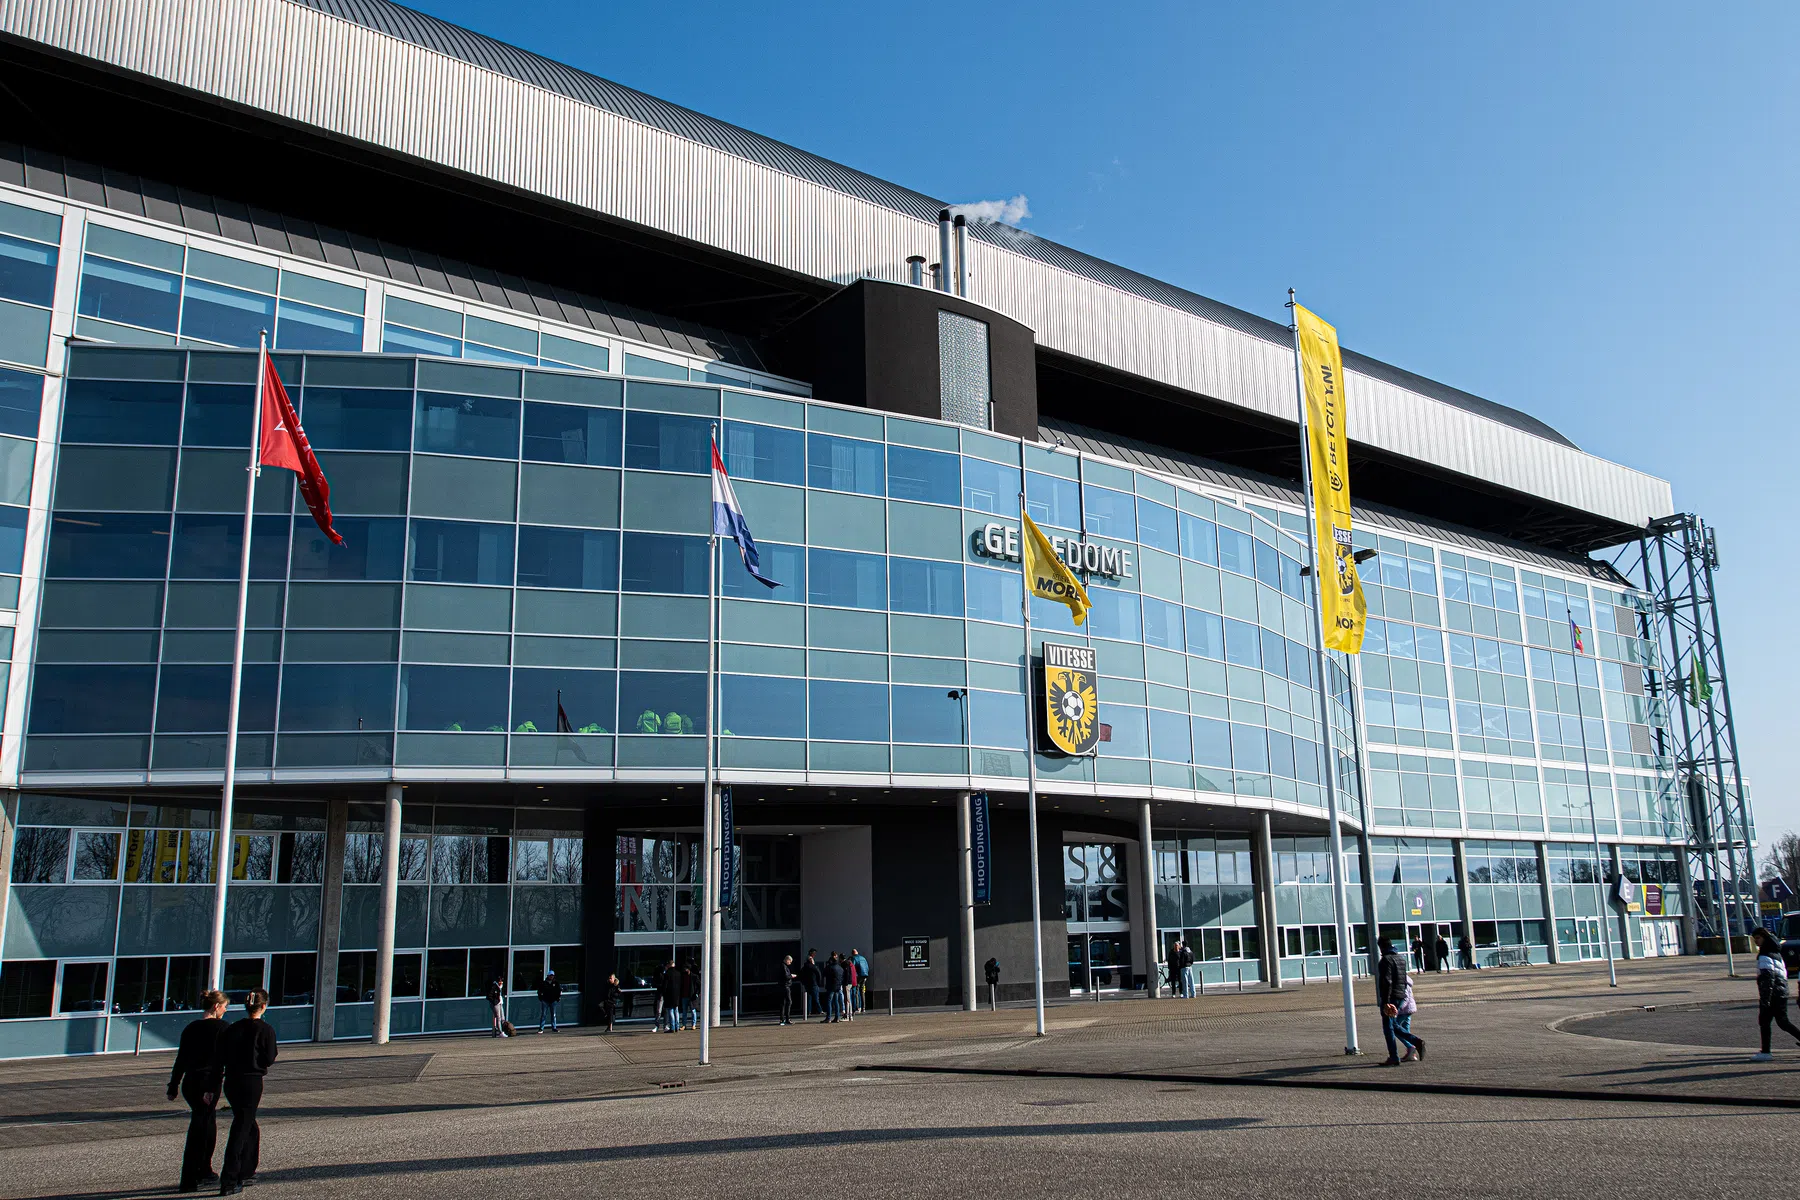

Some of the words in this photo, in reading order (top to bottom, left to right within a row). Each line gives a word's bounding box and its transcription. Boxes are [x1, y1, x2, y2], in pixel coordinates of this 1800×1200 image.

[1321, 363, 1338, 465] BETCITY.NL
[1334, 528, 1352, 543] ESSE
[983, 522, 1134, 578] GEEDOME
[1048, 645, 1094, 669] VITESSE
[722, 793, 731, 890] HOOFDINGANG
[975, 797, 985, 888] HOOFDINGANG
[1416, 897, 1423, 908] D
[1623, 883, 1631, 899] E
[1772, 884, 1780, 899] F
